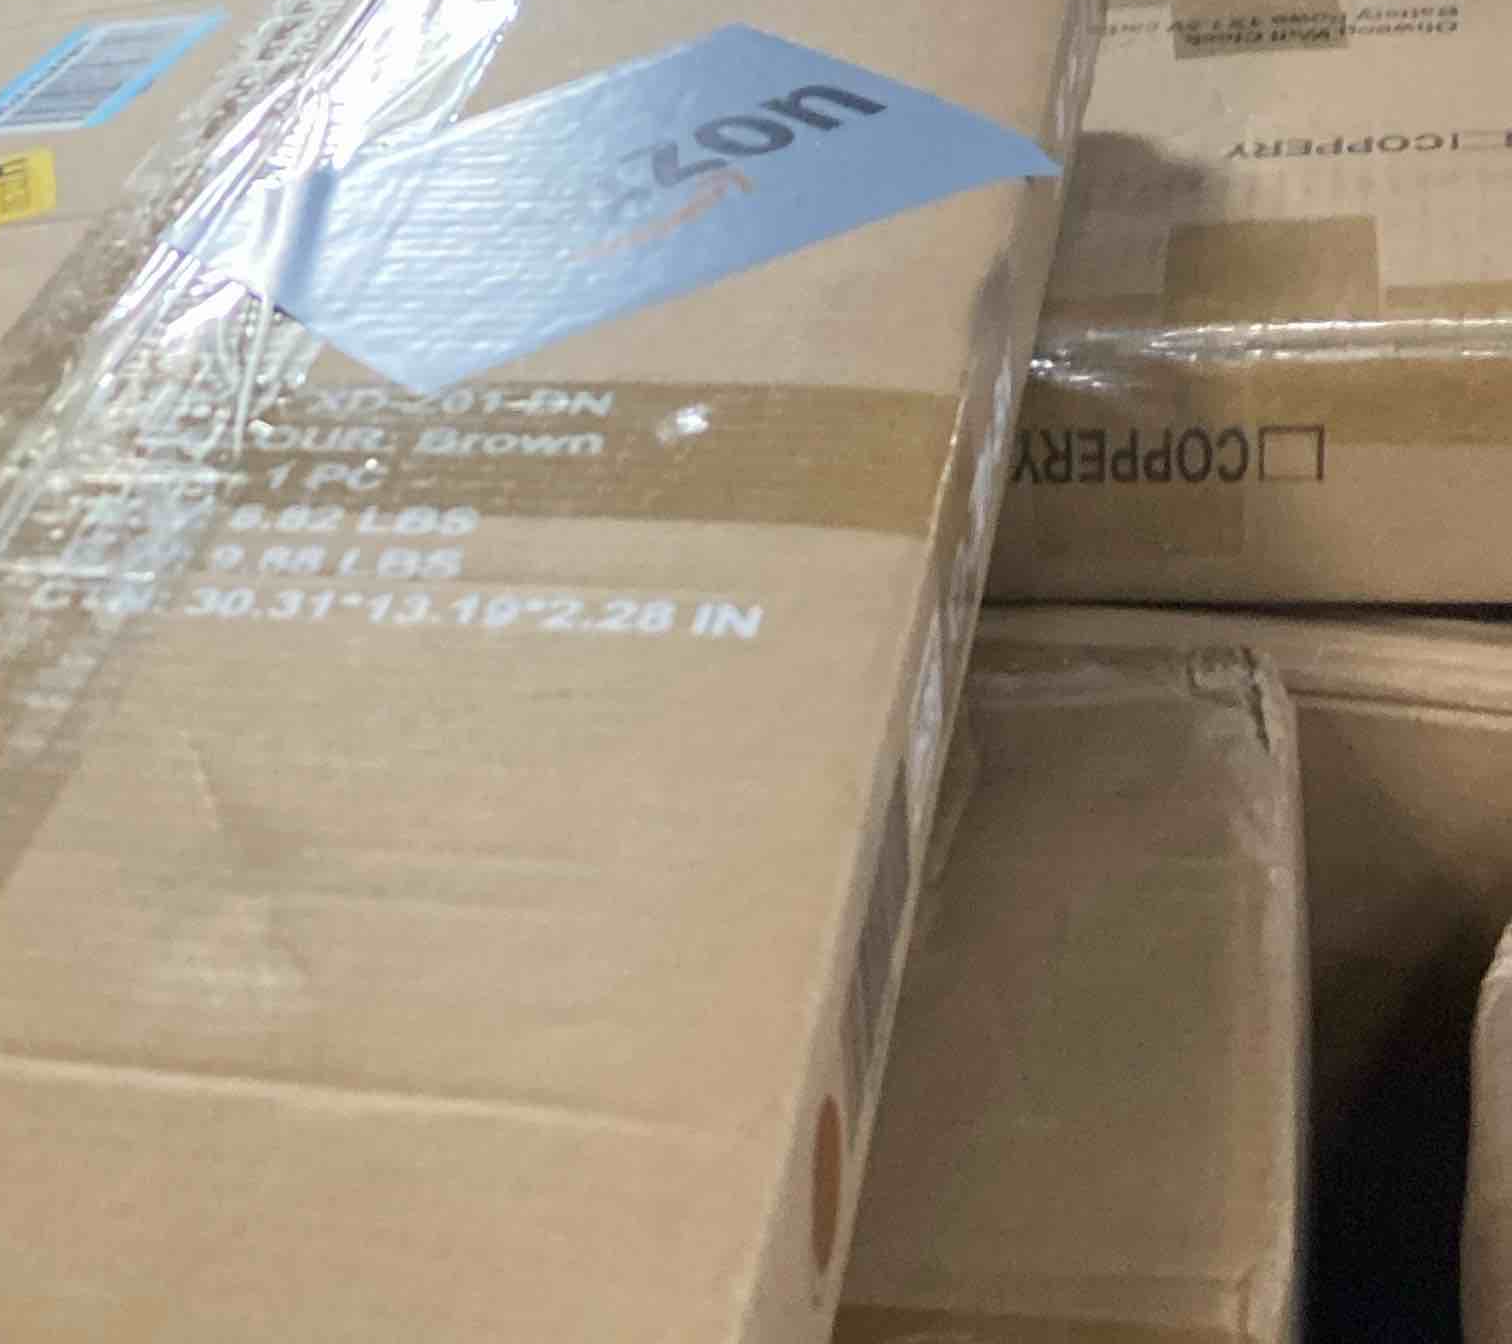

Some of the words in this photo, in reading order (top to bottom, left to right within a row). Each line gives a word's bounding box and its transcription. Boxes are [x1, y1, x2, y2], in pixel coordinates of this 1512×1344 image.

[412, 427, 606, 456] Brown
[1010, 422, 1249, 485] COPPERY
[691, 599, 763, 640] IN
